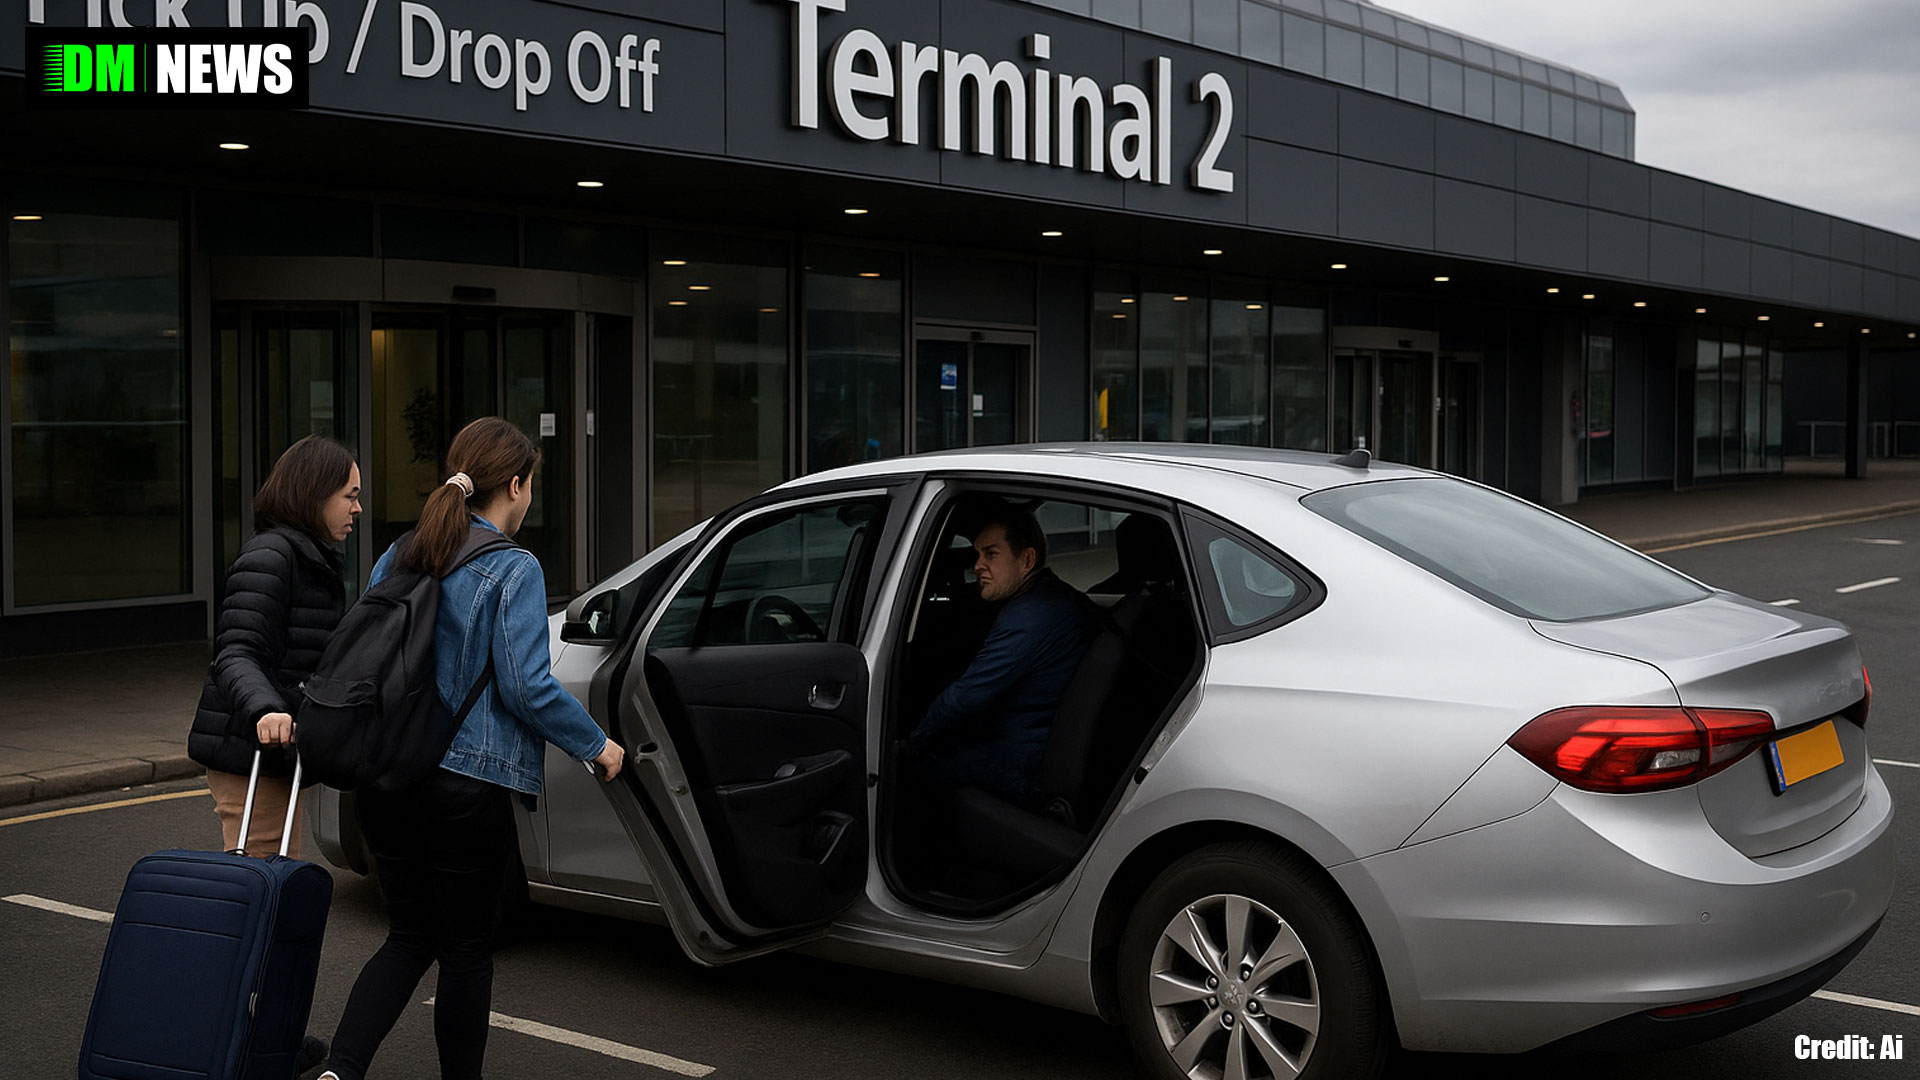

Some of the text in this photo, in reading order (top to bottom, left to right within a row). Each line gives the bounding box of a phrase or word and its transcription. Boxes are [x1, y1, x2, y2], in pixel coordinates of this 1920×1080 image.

[401, 2, 551, 111] Drop
[567, 30, 661, 112] Off
[786, 0, 1234, 193] Terminal 2
